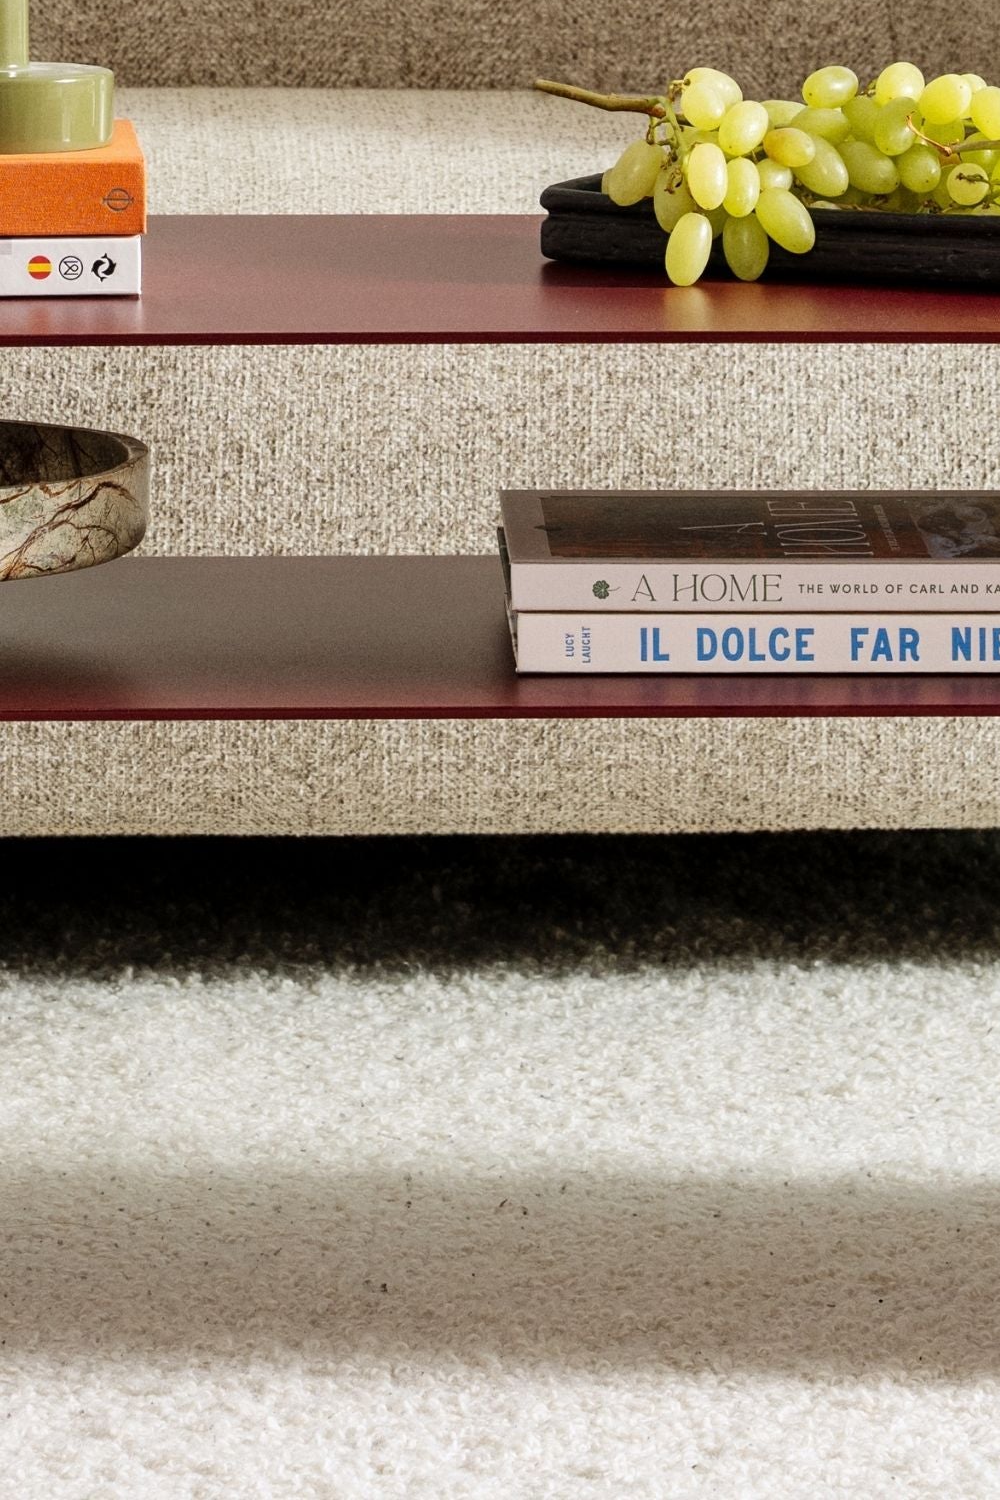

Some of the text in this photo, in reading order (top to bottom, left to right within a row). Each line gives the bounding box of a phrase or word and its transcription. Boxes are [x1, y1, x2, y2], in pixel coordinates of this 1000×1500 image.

[766, 500, 875, 556] HOME
[630, 573, 657, 603] A
[672, 573, 783, 603] HOME
[797, 583, 824, 595] THE
[829, 583, 879, 595] WORLD
[884, 583, 903, 595] OF
[909, 583, 945, 595] CARL
[950, 583, 979, 595] AND
[565, 633, 575, 658] LUCY
[581, 626, 591, 664] LAUCHT
[640, 626, 670, 662] IL
[696, 626, 815, 662] DOLCE
[850, 626, 920, 662] FAR
